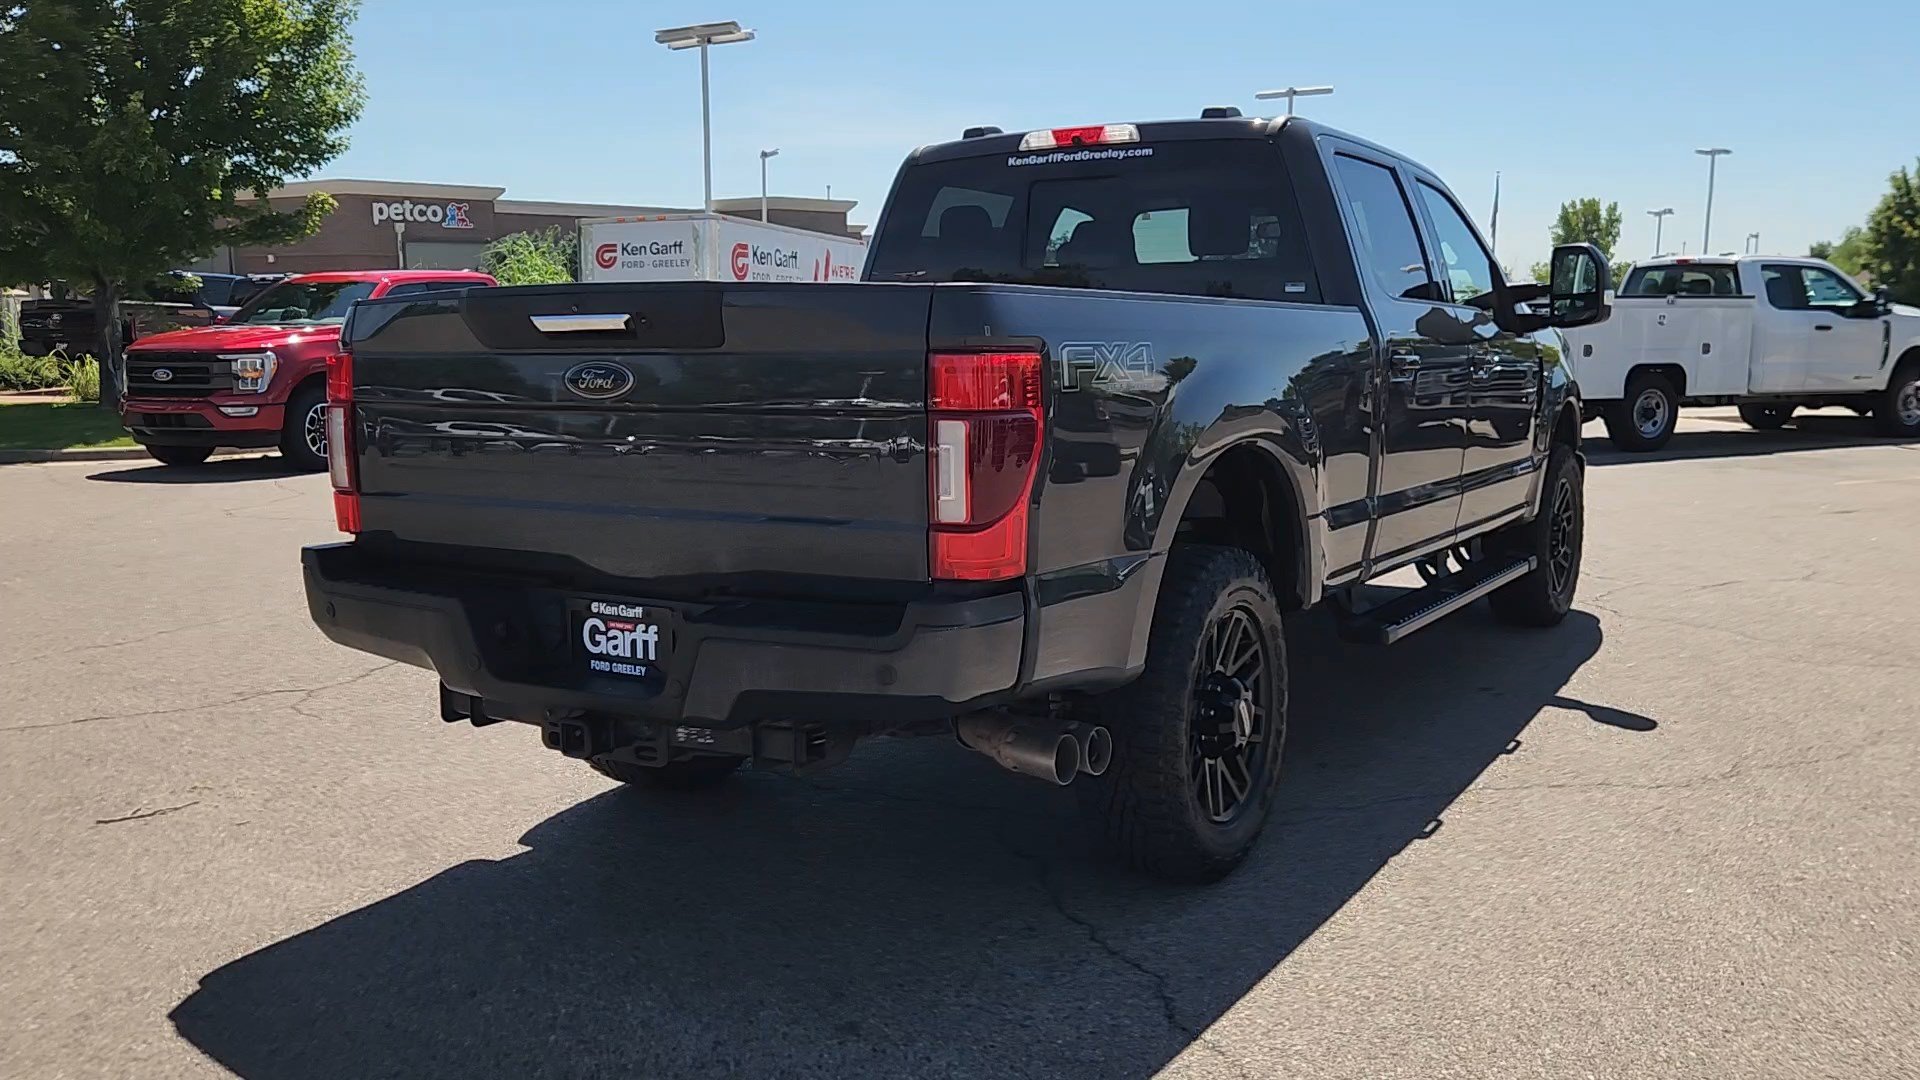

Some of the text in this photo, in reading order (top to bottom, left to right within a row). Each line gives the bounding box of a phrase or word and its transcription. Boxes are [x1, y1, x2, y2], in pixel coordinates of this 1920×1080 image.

[1008, 148, 1153, 167] KenGarffFordGreeley.com
[372, 200, 443, 225] petco
[621, 240, 683, 256] Ken Garff
[752, 244, 798, 269] Ken Garff
[622, 260, 645, 269] FORD
[652, 259, 691, 268] GREELEY
[1058, 341, 1156, 392] FX4
[578, 368, 615, 389] Ford
[599, 602, 643, 618] Ken Garff
[583, 618, 658, 660] Garff
[590, 660, 646, 676] FORD GREELEY
